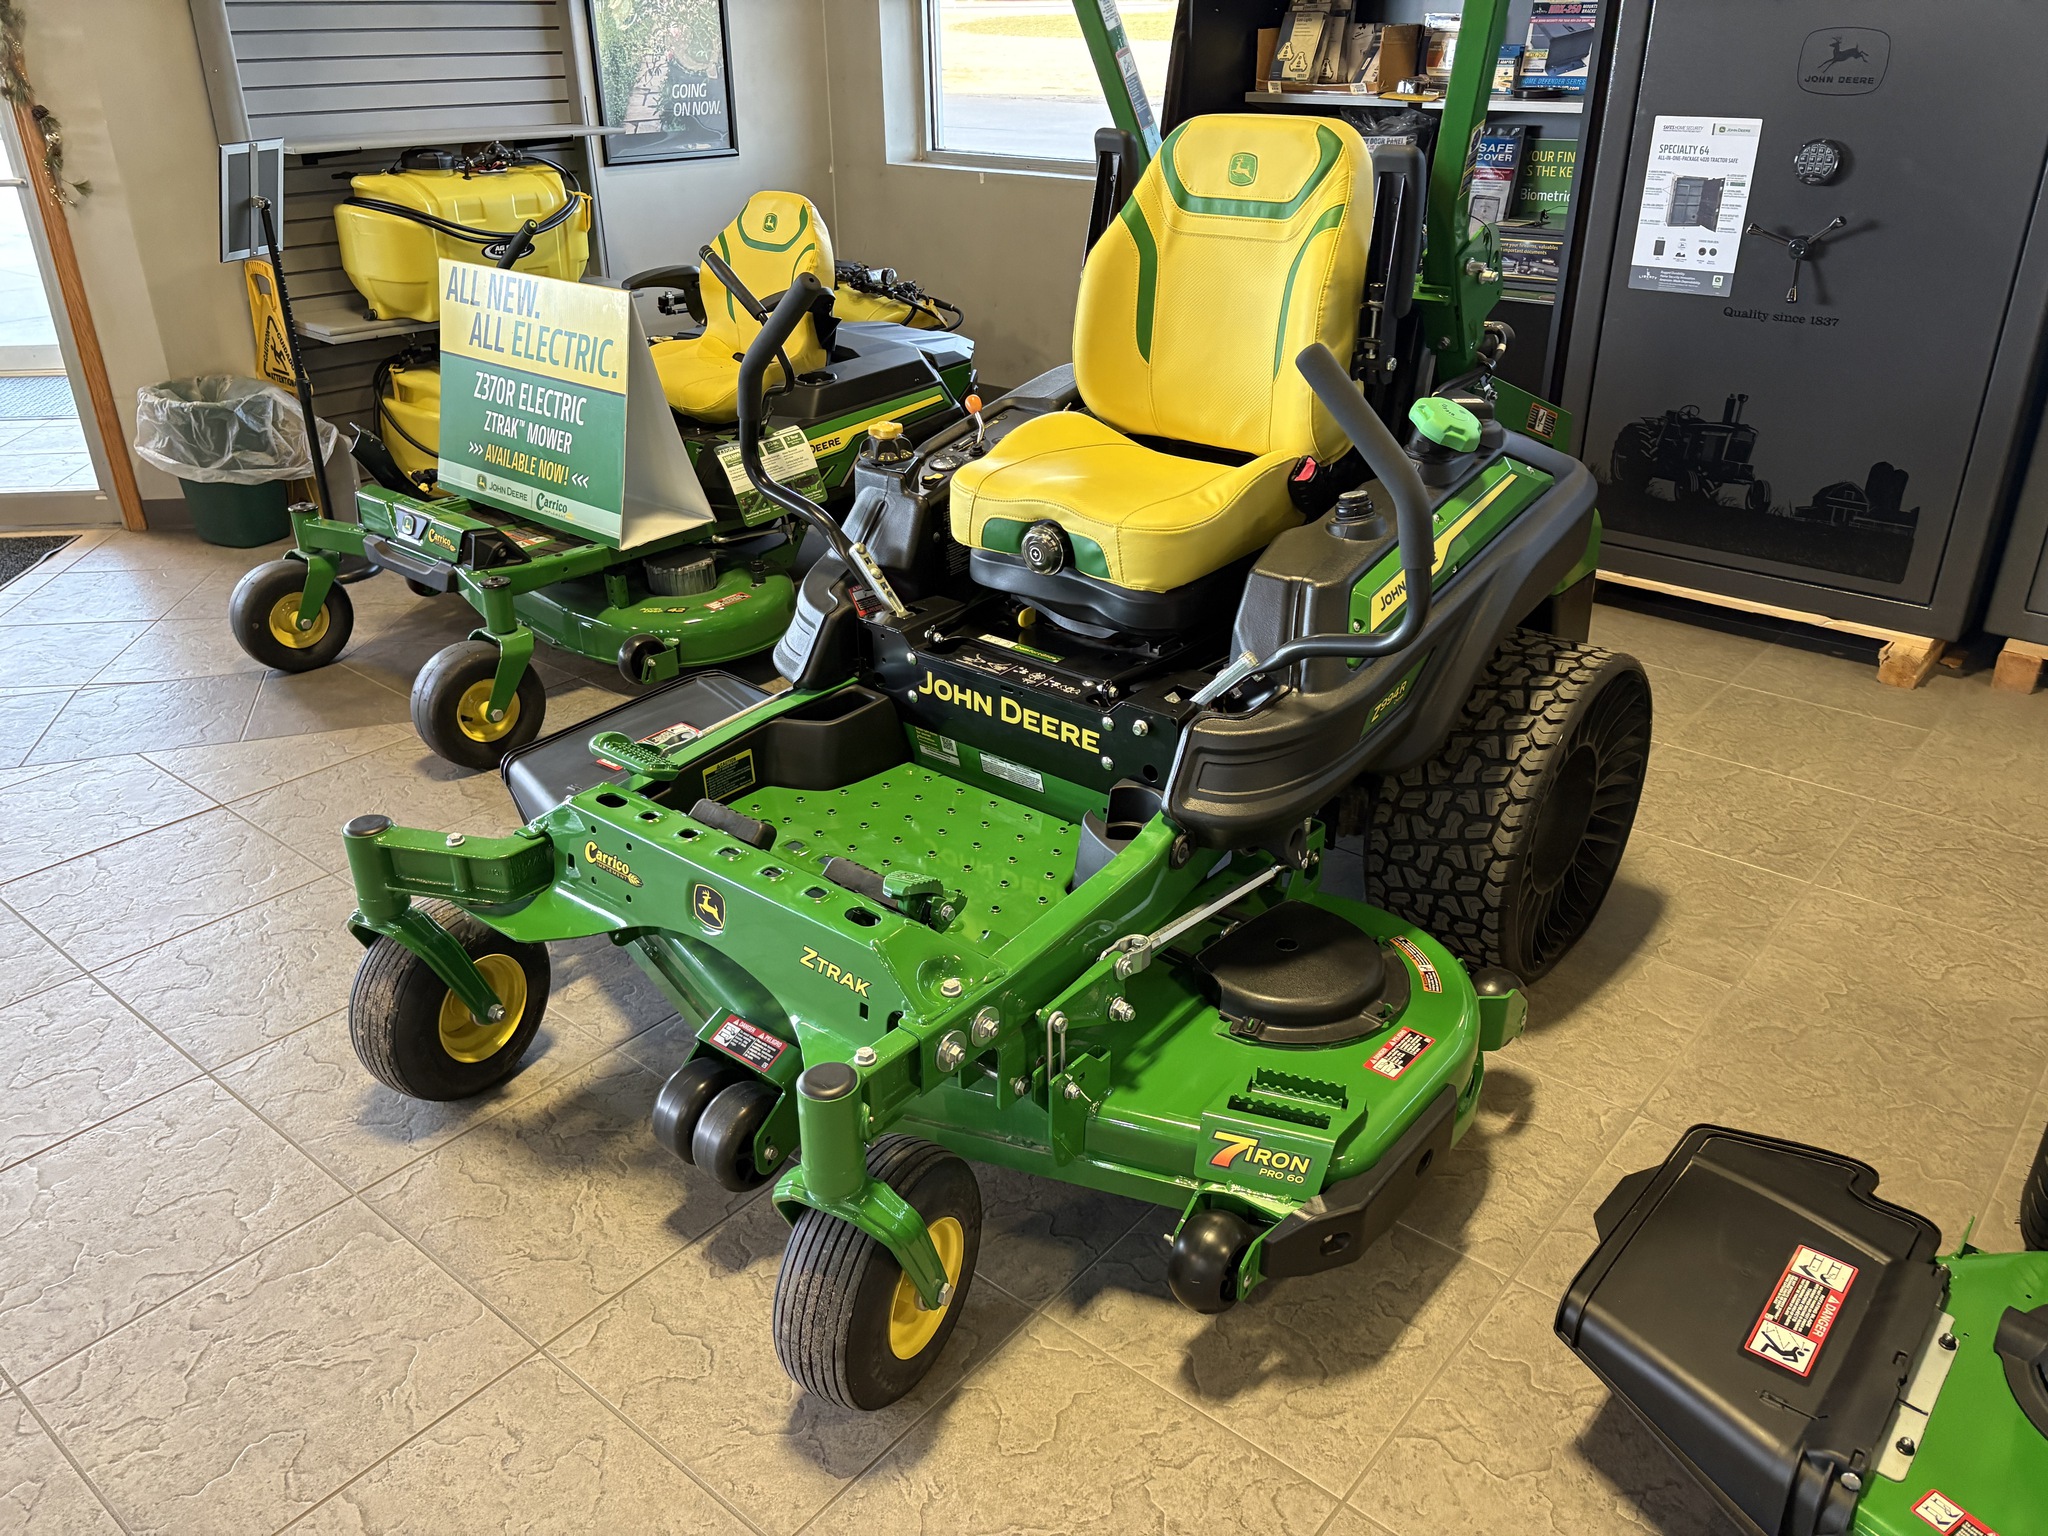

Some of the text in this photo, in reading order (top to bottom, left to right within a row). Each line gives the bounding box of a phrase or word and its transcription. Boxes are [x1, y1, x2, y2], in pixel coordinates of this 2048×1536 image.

[1537, 77, 1565, 85] DEFENDER
[1804, 75, 1875, 84] JOHN DEERE
[672, 83, 707, 99] GOING
[673, 100, 721, 116] ON NOW.
[1476, 153, 1512, 162] COVER
[1479, 143, 1514, 153] SAFE
[1531, 150, 1555, 162] OUR
[1658, 144, 1710, 155] SPECIALTY 64
[1536, 165, 1557, 177] THE
[446, 266, 540, 319] ALL NEW.
[1723, 306, 1839, 327] Quality since 1837
[263, 328, 271, 362] CAUTION
[277, 332, 295, 370] CUIDADO
[469, 312, 617, 378] ALL ELECTRIC.
[473, 371, 587, 425] Z370R ELECTRIC
[527, 425, 572, 454] MOWER
[485, 443, 570, 485] AVAILABLE NOW!
[489, 482, 528, 502] JOHN DEERE
[535, 492, 568, 514] Carrico
[428, 528, 452, 548] Carrico
[1380, 580, 1407, 611] JOHN
[918, 671, 993, 717] JOHN
[1000, 695, 1100, 755] DEERE
[585, 841, 630, 875] Carrico
[799, 945, 872, 999] ZTRAK
[739, 1021, 757, 1034] DANGER
[764, 1034, 783, 1048] PELIGRO
[1391, 1029, 1407, 1042] PELIGRO
[1373, 1047, 1389, 1061] DANGER
[1258, 1167, 1304, 1184] PRO 60
[1812, 1301, 1839, 1338] DANGER
